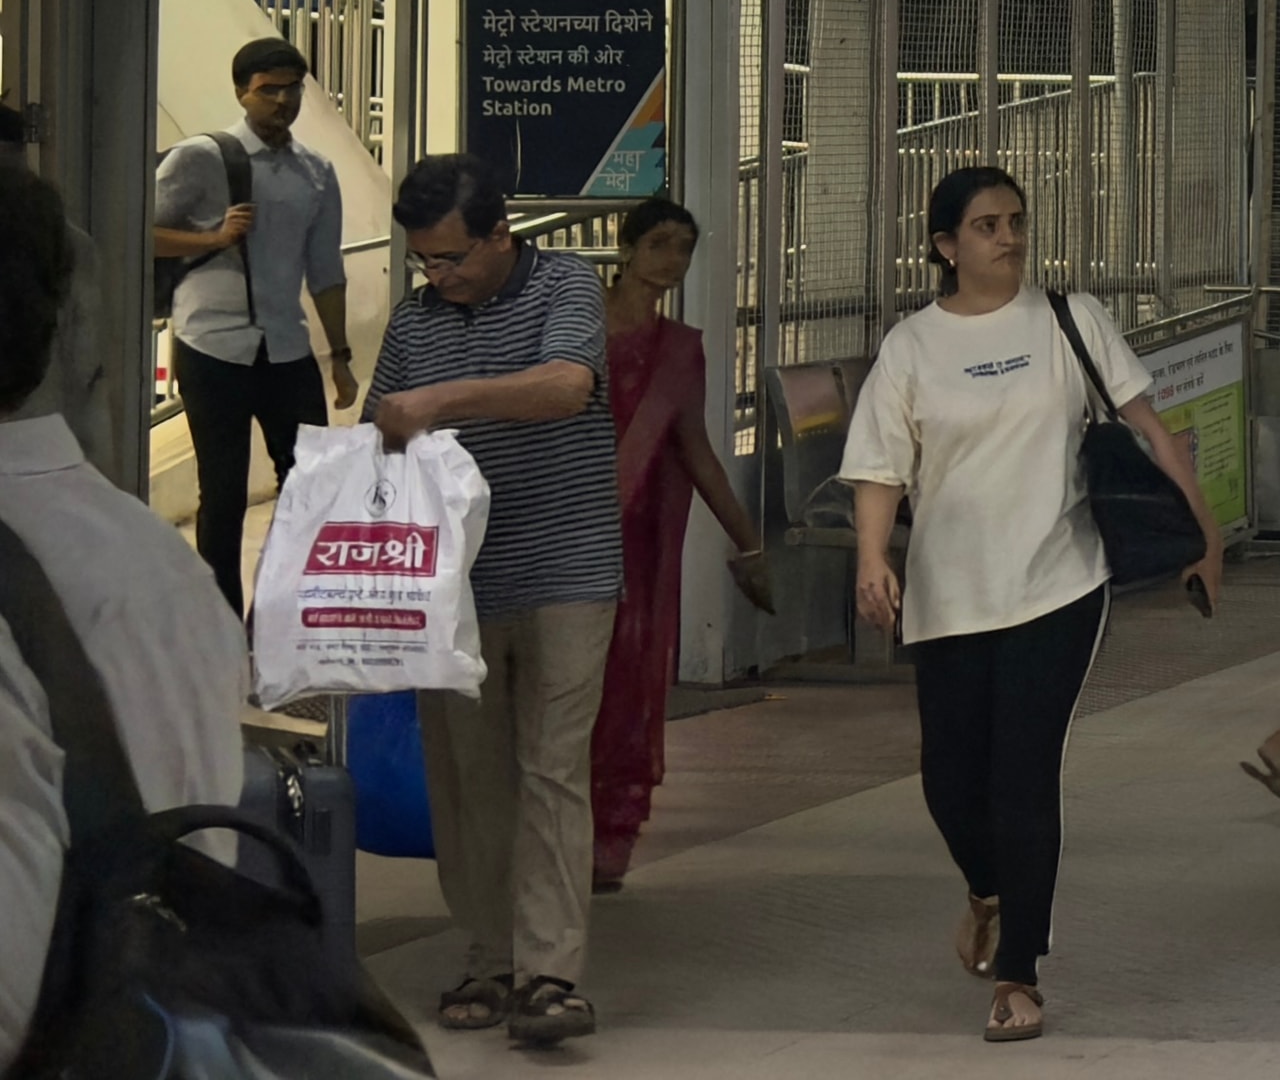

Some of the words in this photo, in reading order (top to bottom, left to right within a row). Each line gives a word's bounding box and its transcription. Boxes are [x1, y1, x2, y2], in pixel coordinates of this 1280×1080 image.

[482, 9, 515, 38] मेट्रो
[520, 8, 600, 33] स्टेशनच्या
[605, 8, 654, 35] दिशेने
[482, 44, 512, 69] मेट्रो
[517, 44, 563, 66] स्टेशन
[568, 44, 590, 65] की
[594, 44, 624, 66] ओर
[482, 76, 562, 93] Towards
[567, 76, 626, 93] Metro
[482, 99, 553, 117] Station
[611, 149, 645, 172] महा
[597, 168, 636, 192] मेट्रो
[316, 531, 429, 568] राजश्री
